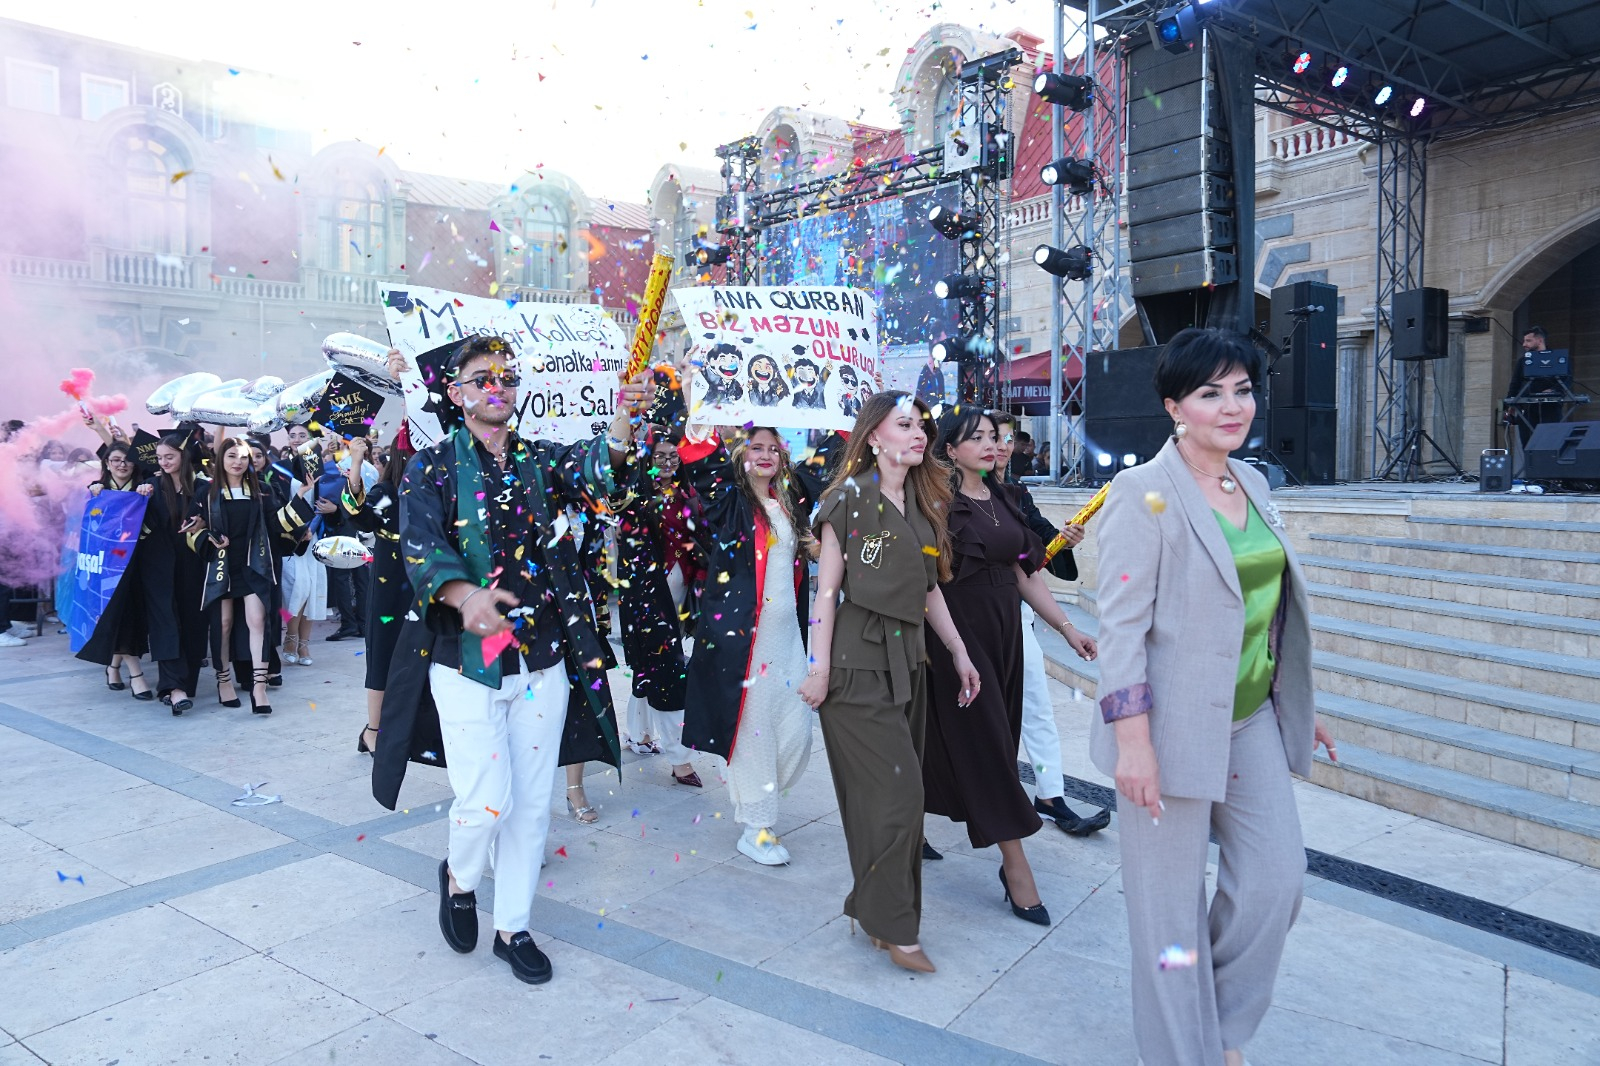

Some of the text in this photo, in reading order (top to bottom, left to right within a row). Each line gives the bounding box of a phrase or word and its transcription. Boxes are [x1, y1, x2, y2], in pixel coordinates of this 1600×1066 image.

[714, 290, 864, 320] ANA QURBAN
[328, 391, 364, 407] NMK
[1001, 386, 1023, 398] SAAT
